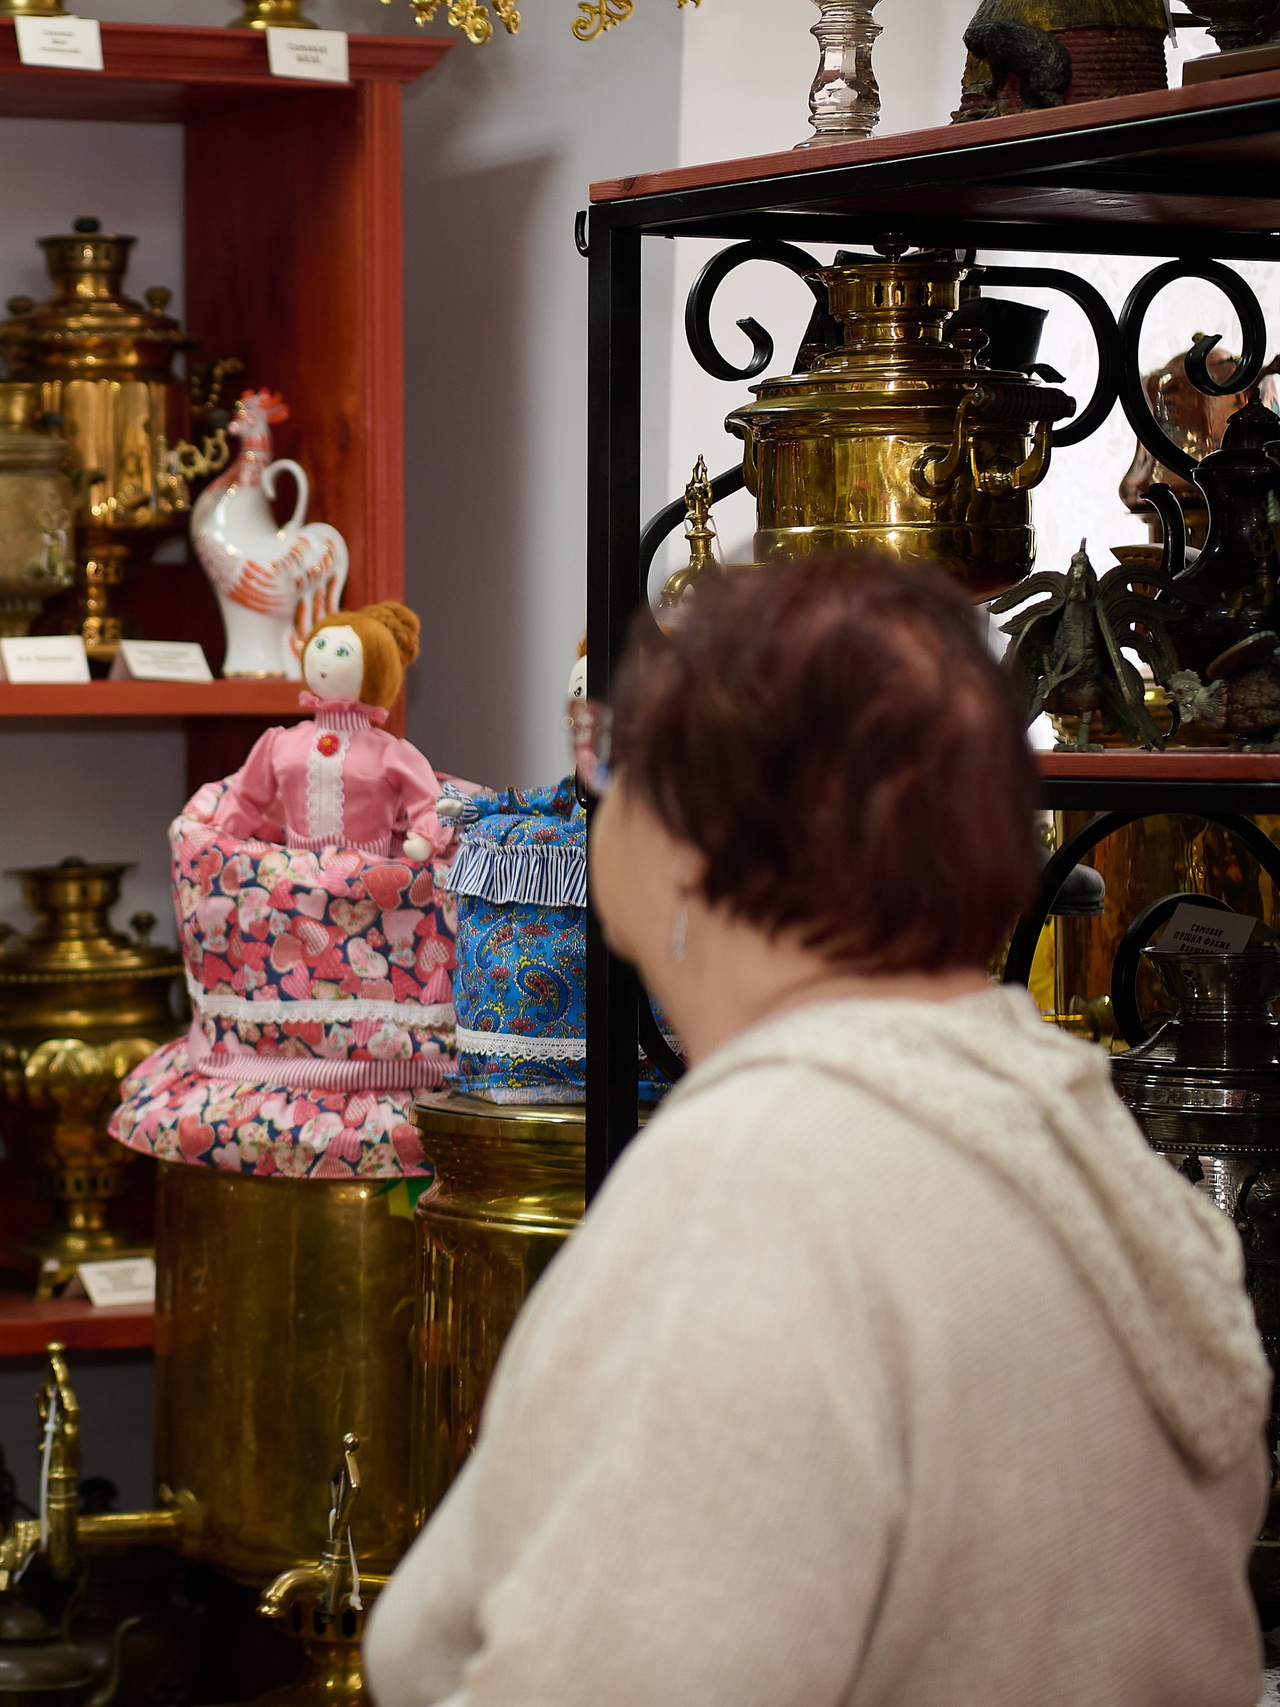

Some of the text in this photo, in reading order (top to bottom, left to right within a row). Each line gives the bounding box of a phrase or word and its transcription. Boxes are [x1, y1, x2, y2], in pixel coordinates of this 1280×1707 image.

[1190, 923, 1224, 938] Самовар
[1173, 931, 1231, 950] ПУШКА Фраже
